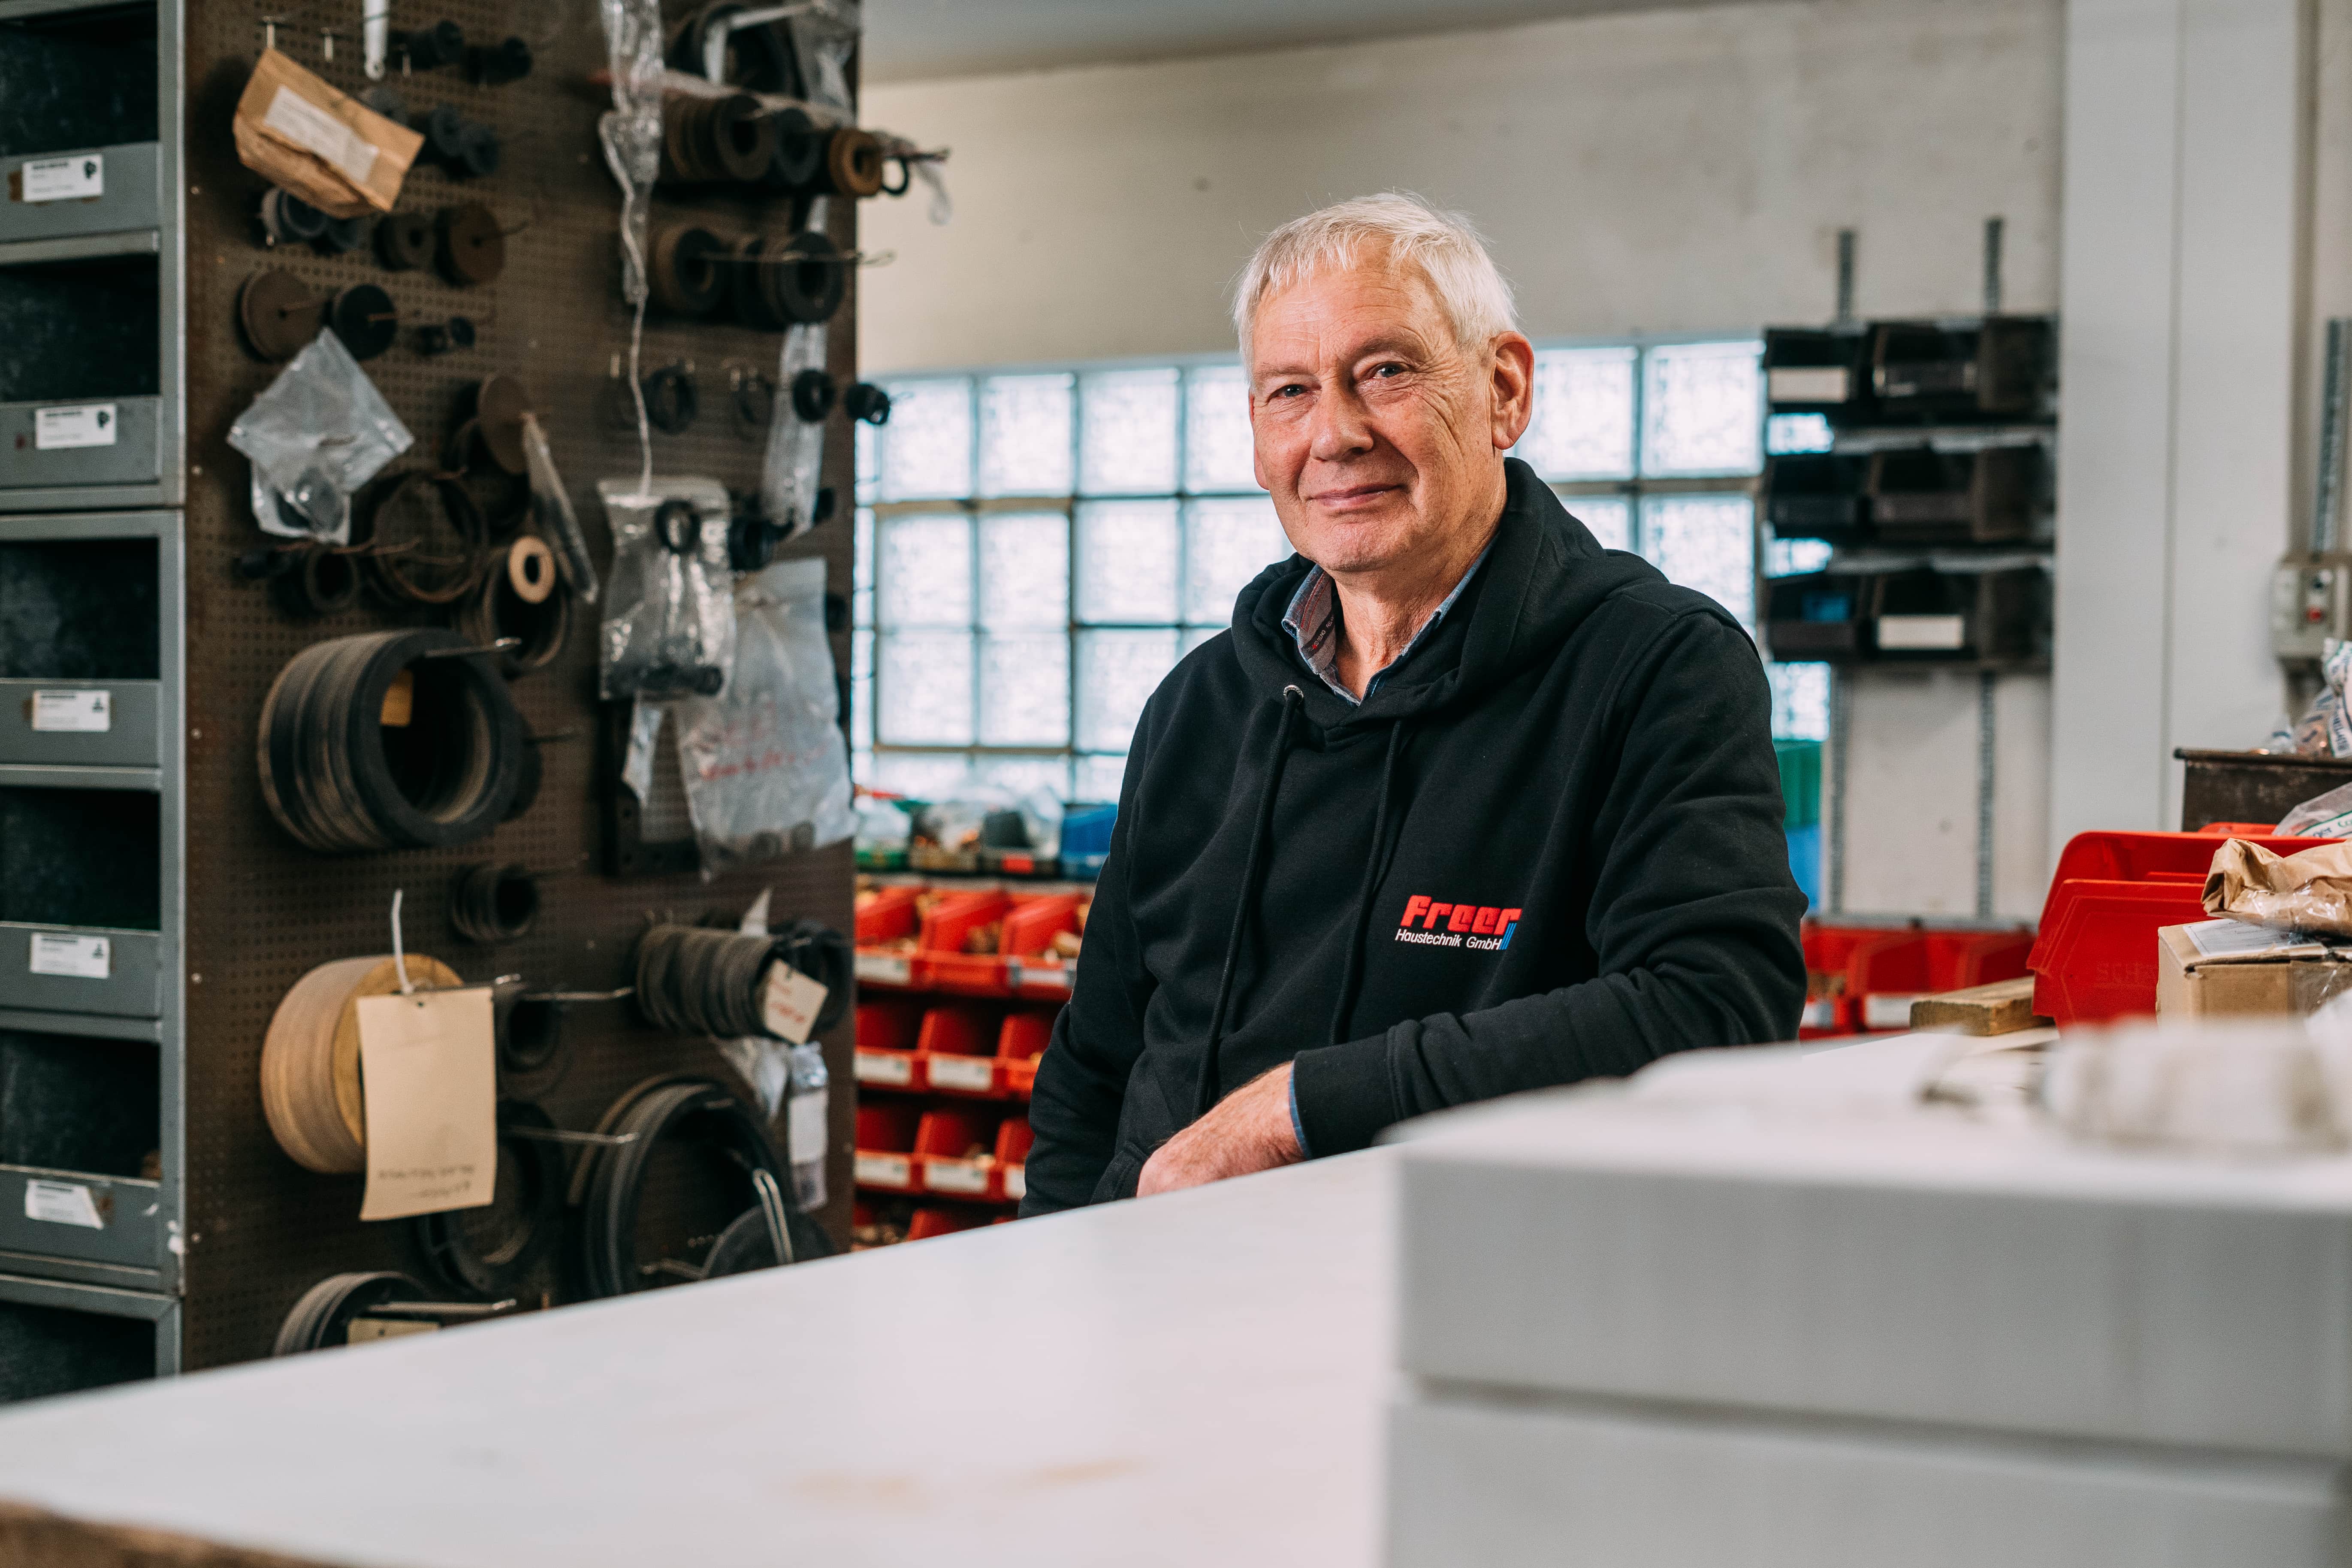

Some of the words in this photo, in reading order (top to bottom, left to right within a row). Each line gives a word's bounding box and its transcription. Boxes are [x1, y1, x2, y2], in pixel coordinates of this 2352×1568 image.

[1400, 894, 1522, 935] Freer
[1395, 928, 1462, 947] Haustechnik
[1466, 936, 1503, 950] GmbH
